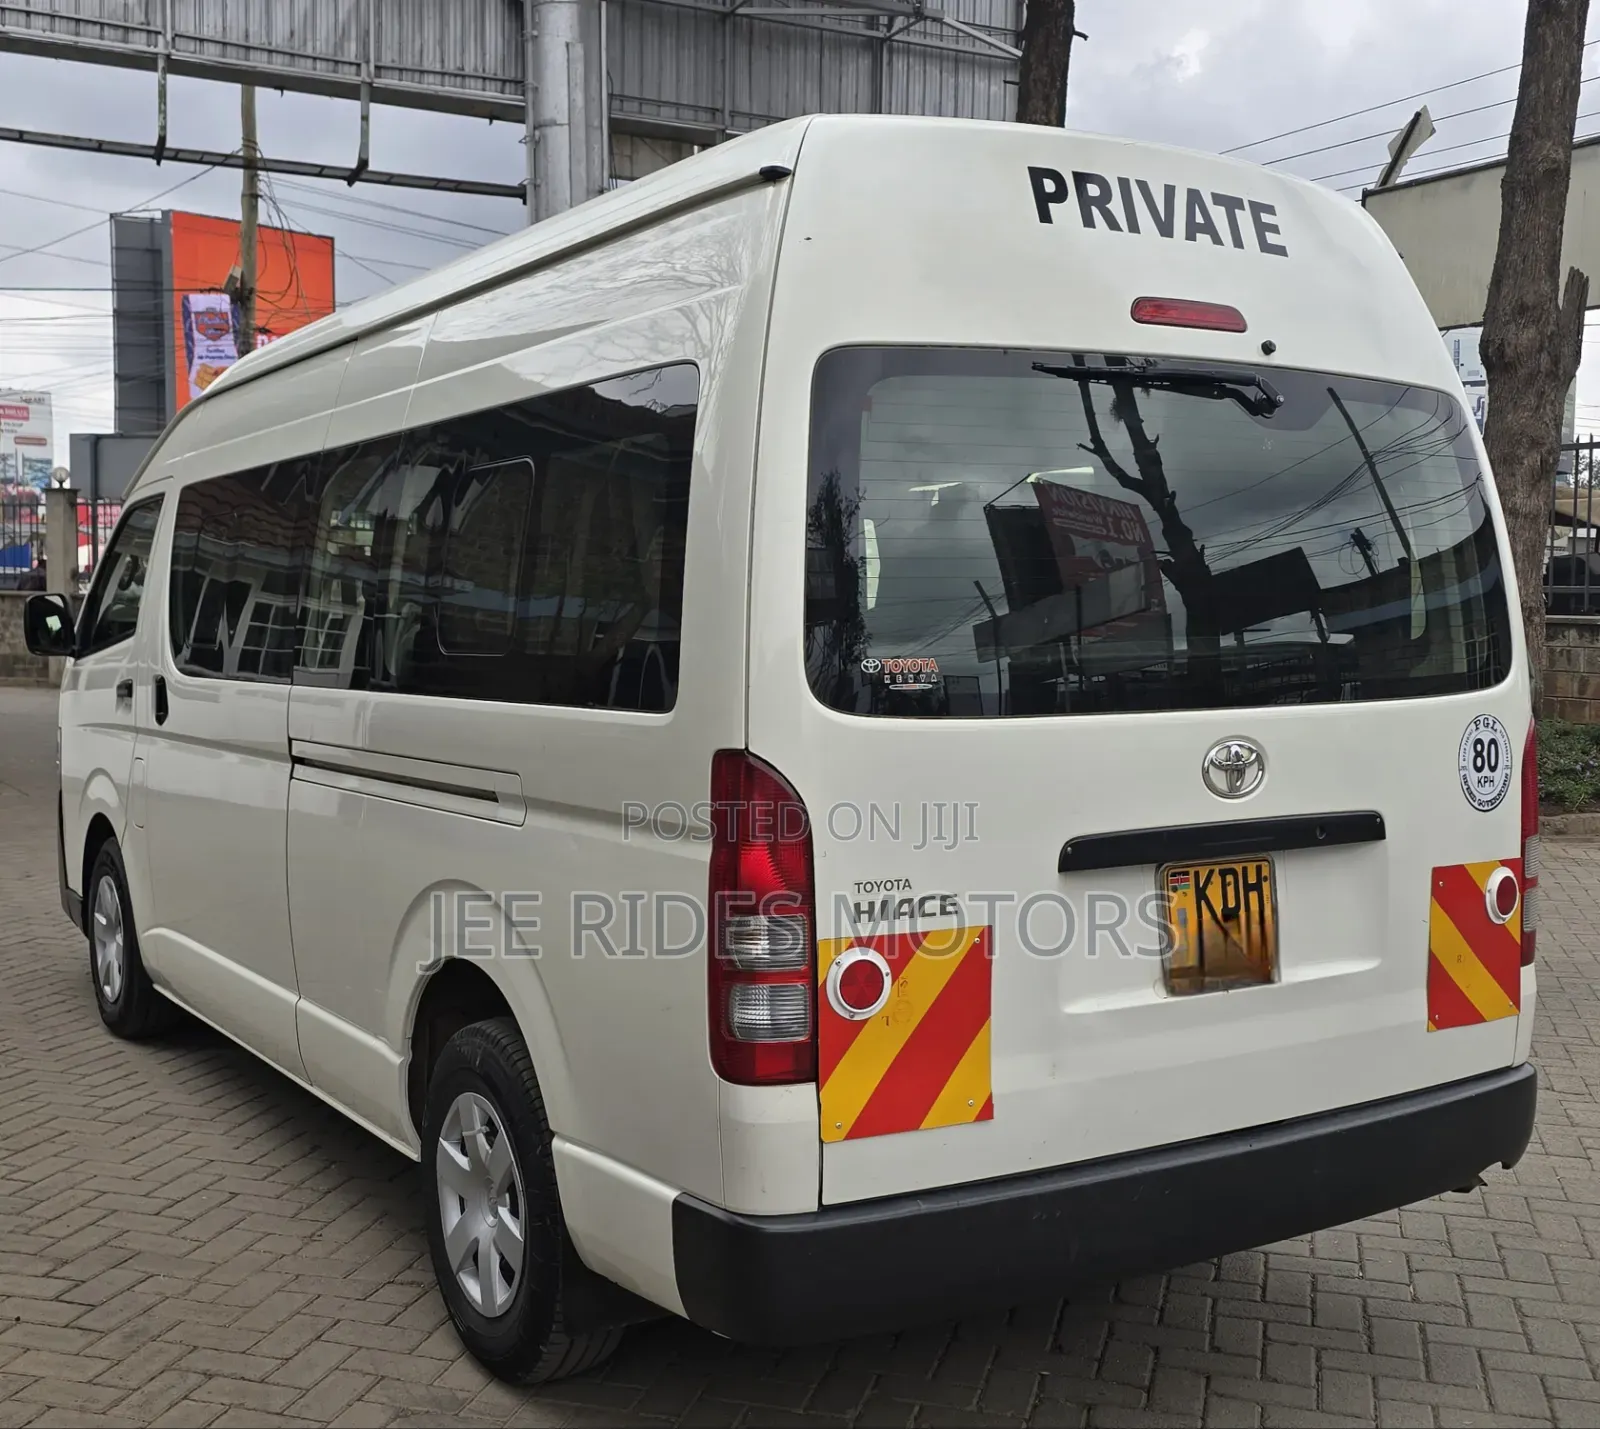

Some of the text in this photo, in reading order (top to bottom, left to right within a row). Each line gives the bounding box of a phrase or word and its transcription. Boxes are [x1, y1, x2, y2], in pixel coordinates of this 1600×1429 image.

[1027, 166, 1289, 258] PRIVATE
[881, 658, 939, 674] TOYOTA
[884, 674, 938, 684] KENYA
[1473, 716, 1498, 732] PGL
[1473, 738, 1500, 773] 80
[1477, 775, 1495, 788] KPH
[854, 878, 913, 894] TOYOTA
[1193, 864, 1265, 920] KDH
[853, 893, 960, 924] HIACE
